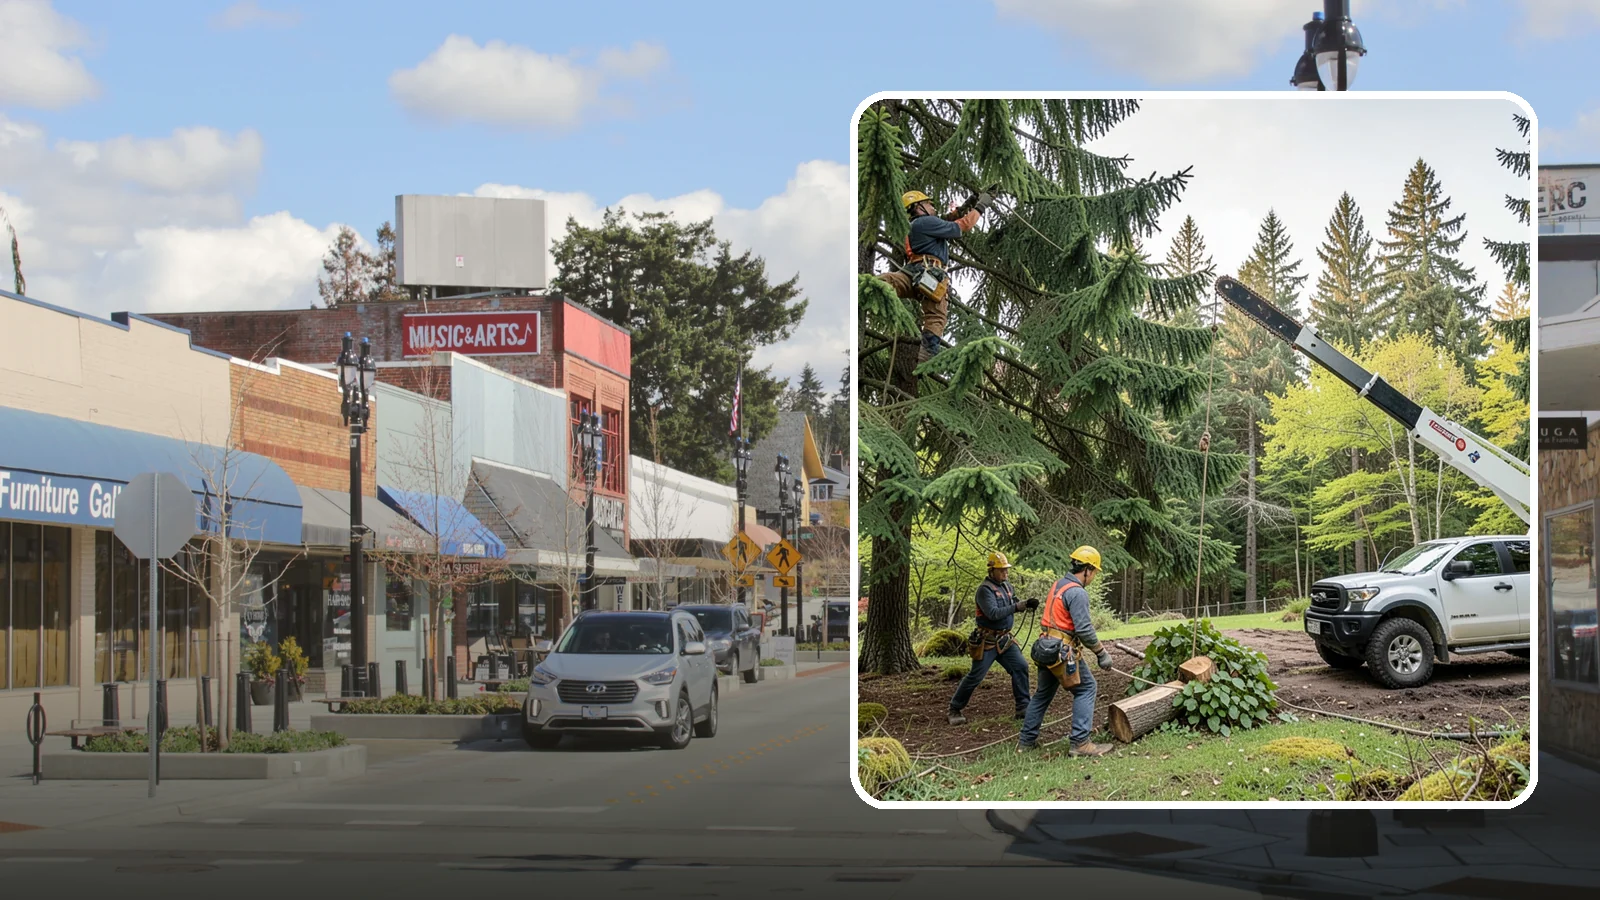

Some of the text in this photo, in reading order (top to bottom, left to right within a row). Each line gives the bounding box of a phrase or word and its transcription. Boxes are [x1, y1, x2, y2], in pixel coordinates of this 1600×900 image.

[409, 322, 519, 349] MUSIC&ARTS
[0, 471, 122, 519] Furniture Gal
